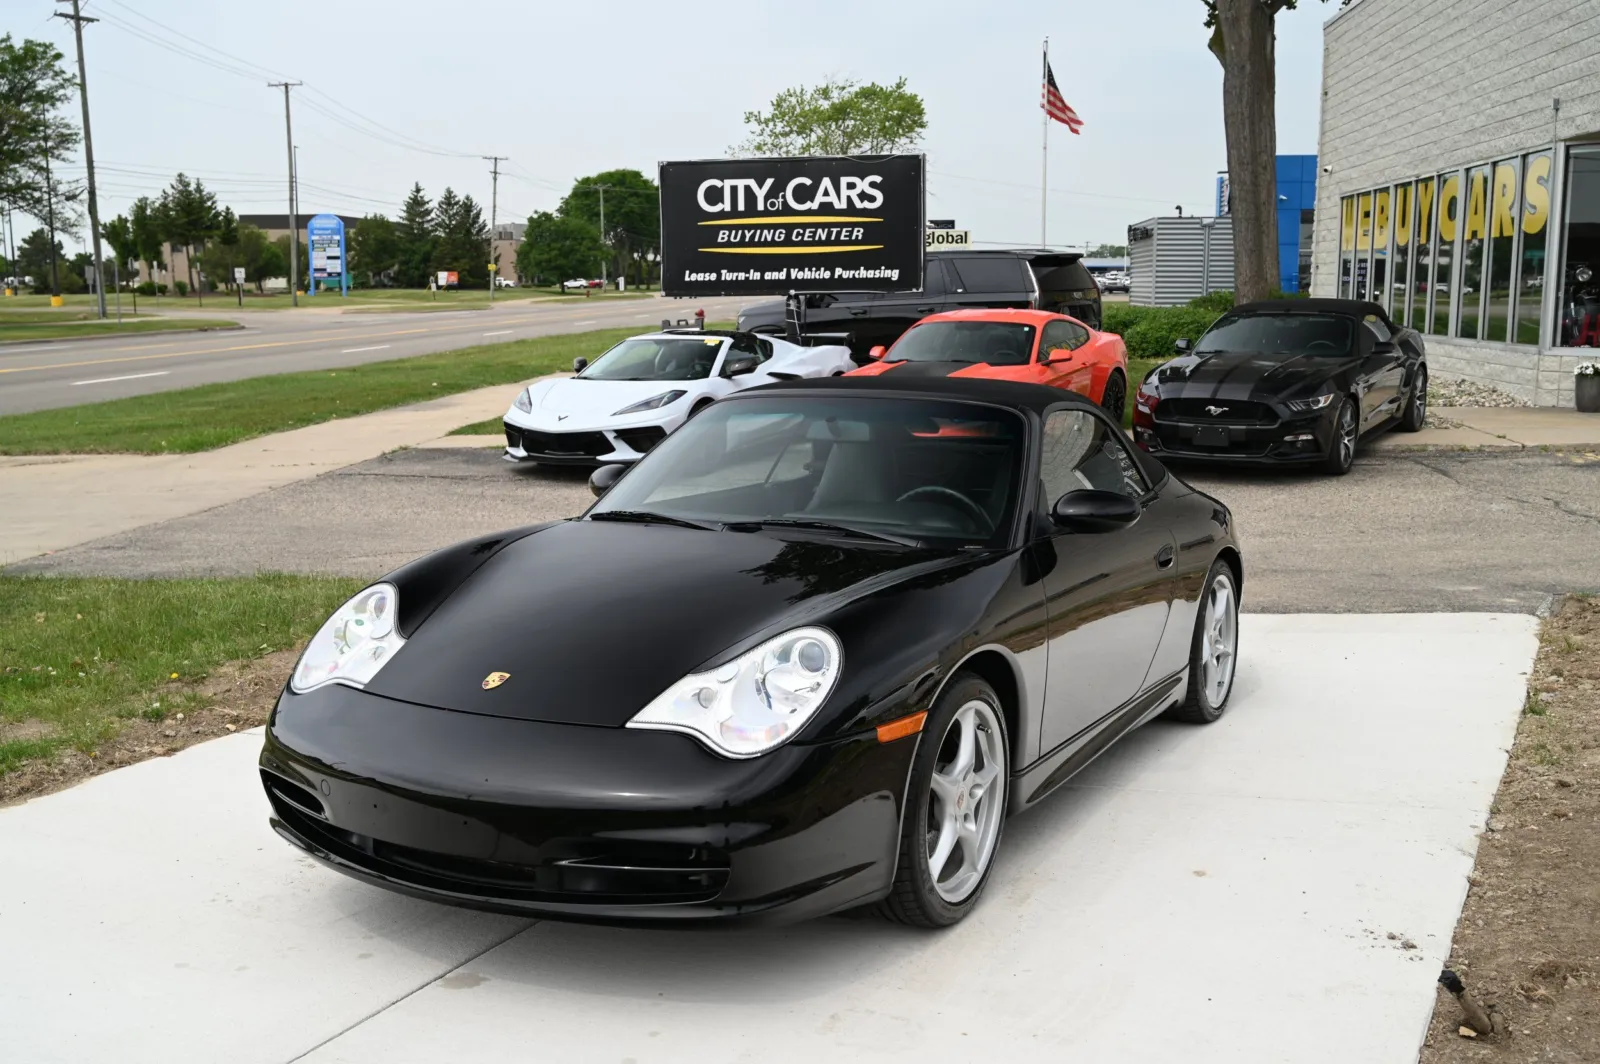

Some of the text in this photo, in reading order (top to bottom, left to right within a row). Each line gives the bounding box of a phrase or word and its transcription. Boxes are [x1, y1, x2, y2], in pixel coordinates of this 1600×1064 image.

[697, 175, 884, 213] CITY of CARS
[1440, 155, 1551, 241] CARS
[717, 227, 864, 243] BUYING CENTER
[684, 266, 899, 282] Lease Turn-In and Vehicle Purchasing
